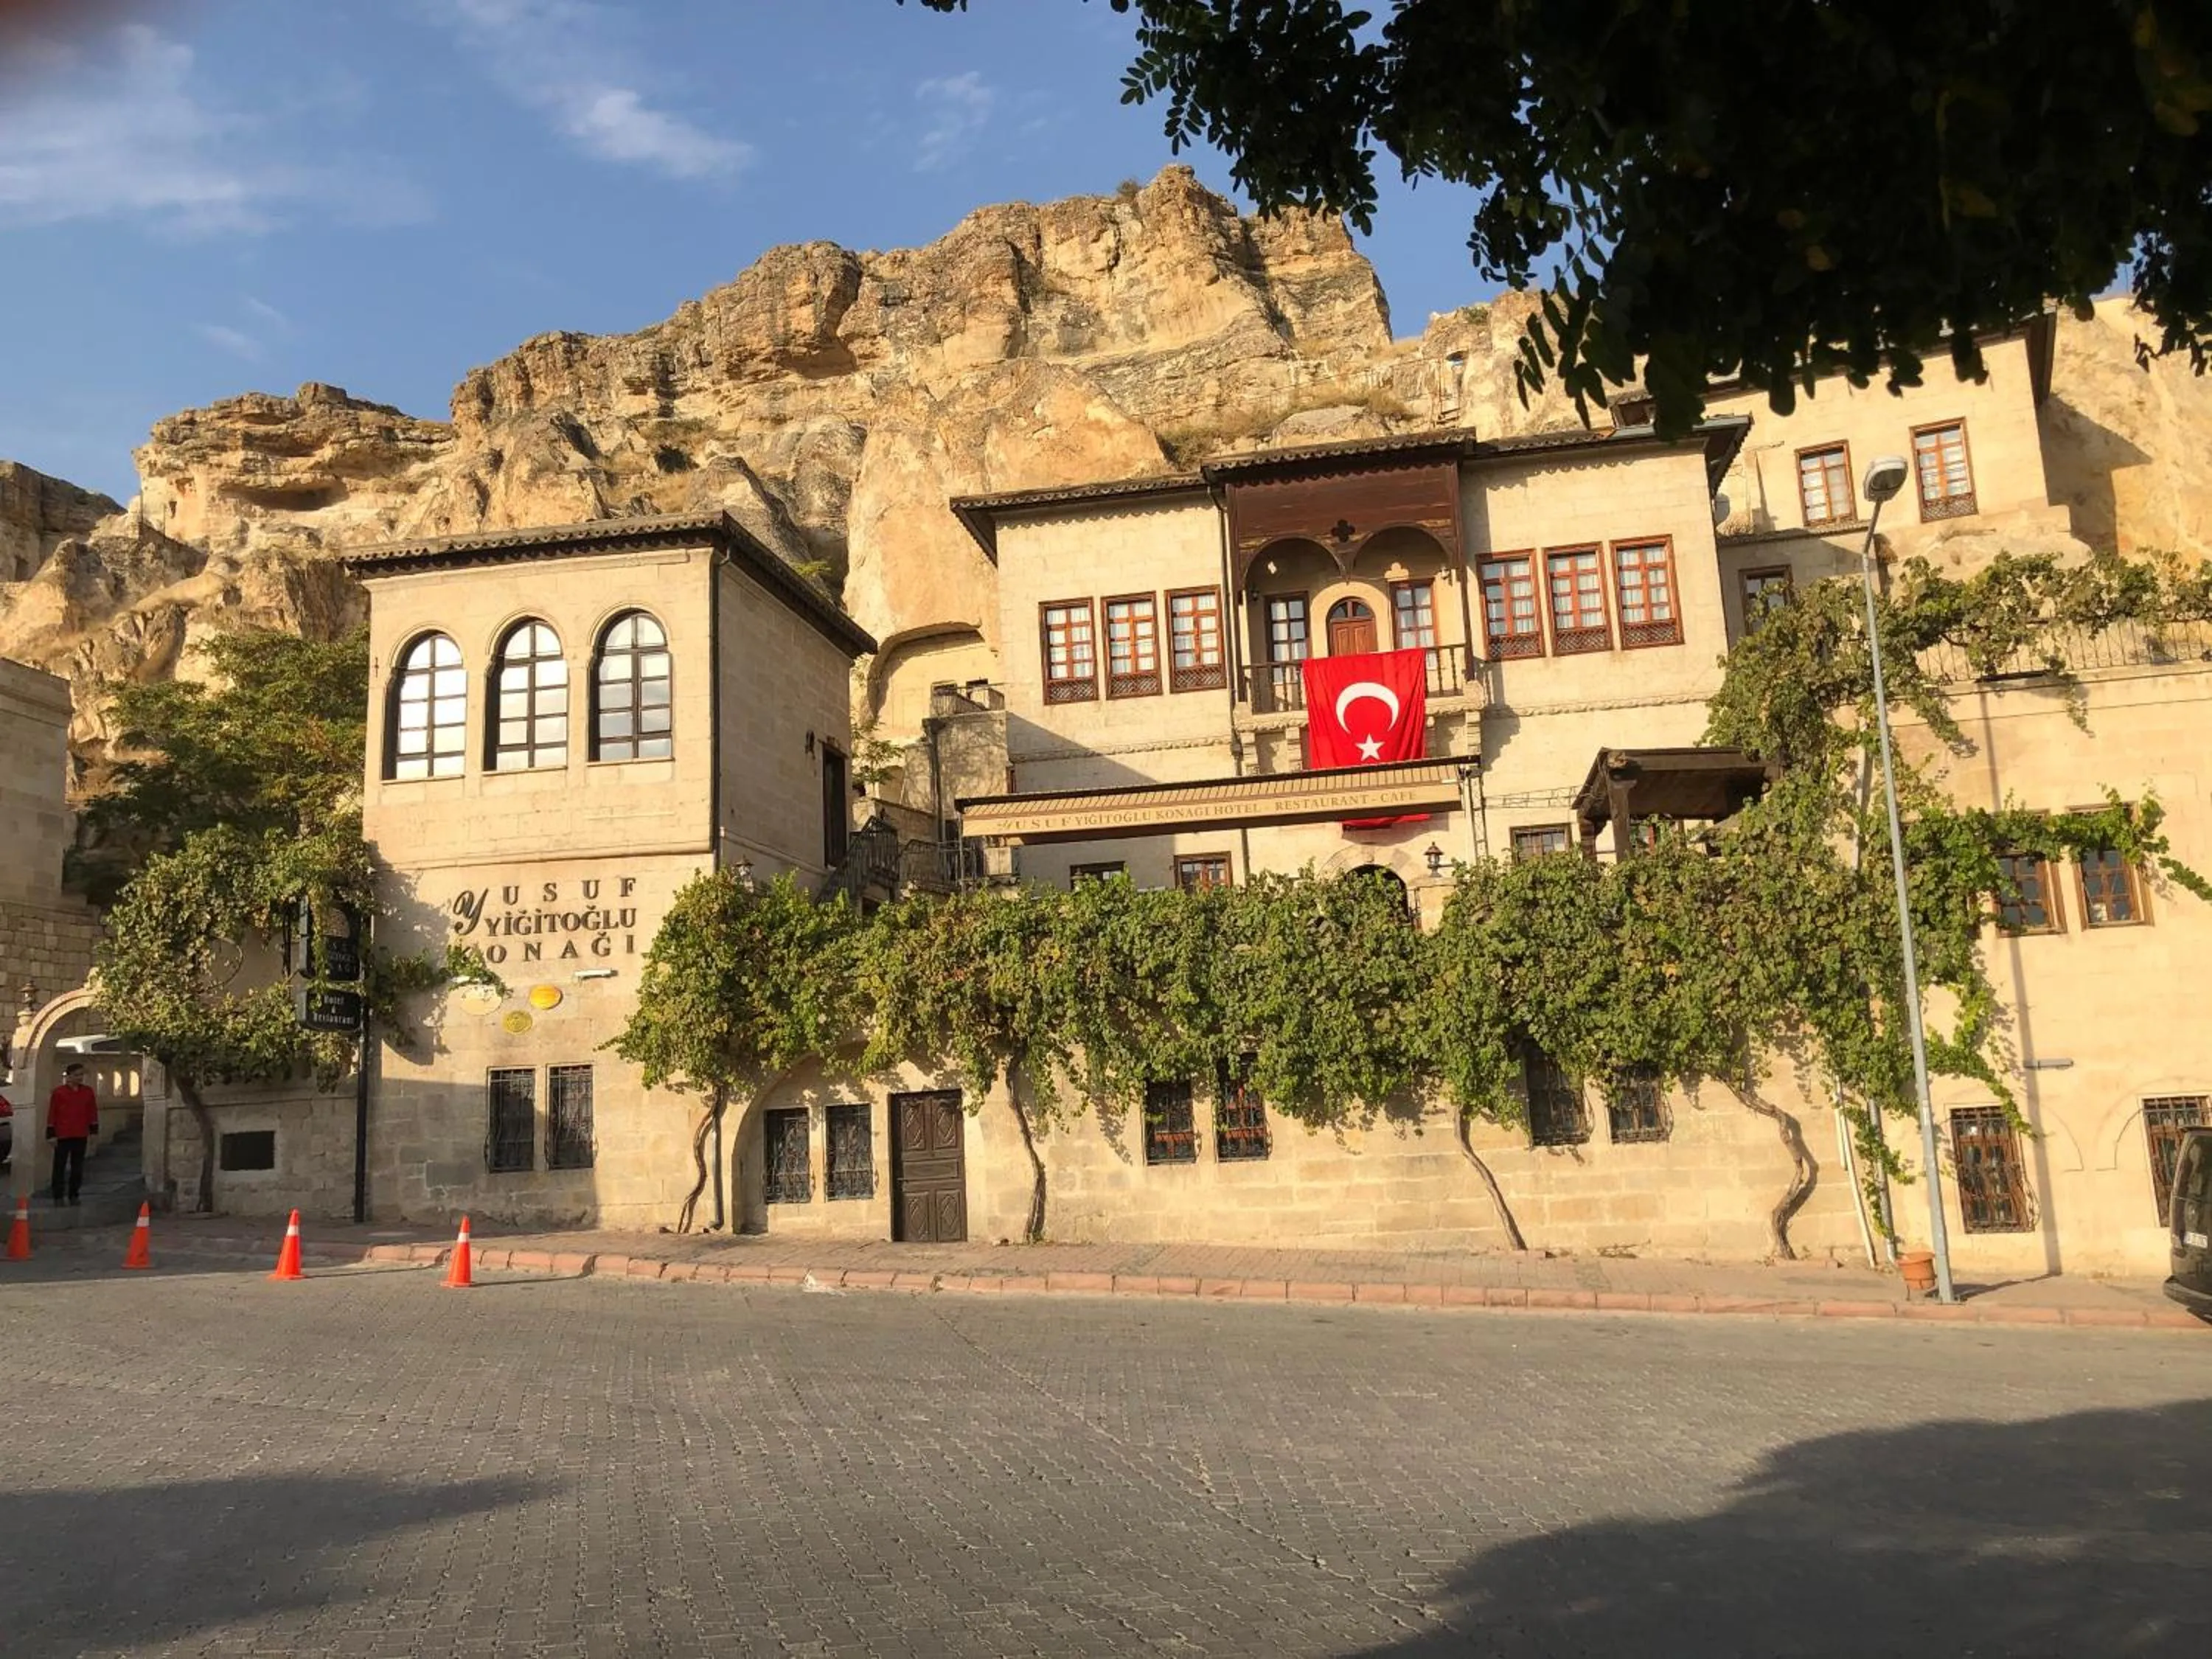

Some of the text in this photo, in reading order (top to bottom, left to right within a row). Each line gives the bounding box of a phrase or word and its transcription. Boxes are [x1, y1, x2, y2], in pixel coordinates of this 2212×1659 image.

[1214, 803, 1262, 815] HOTEL
[1275, 794, 1369, 811] RESTAURANT
[484, 905, 636, 936] YİĞİTOĞLU
[462, 932, 635, 964] ONAĞI
